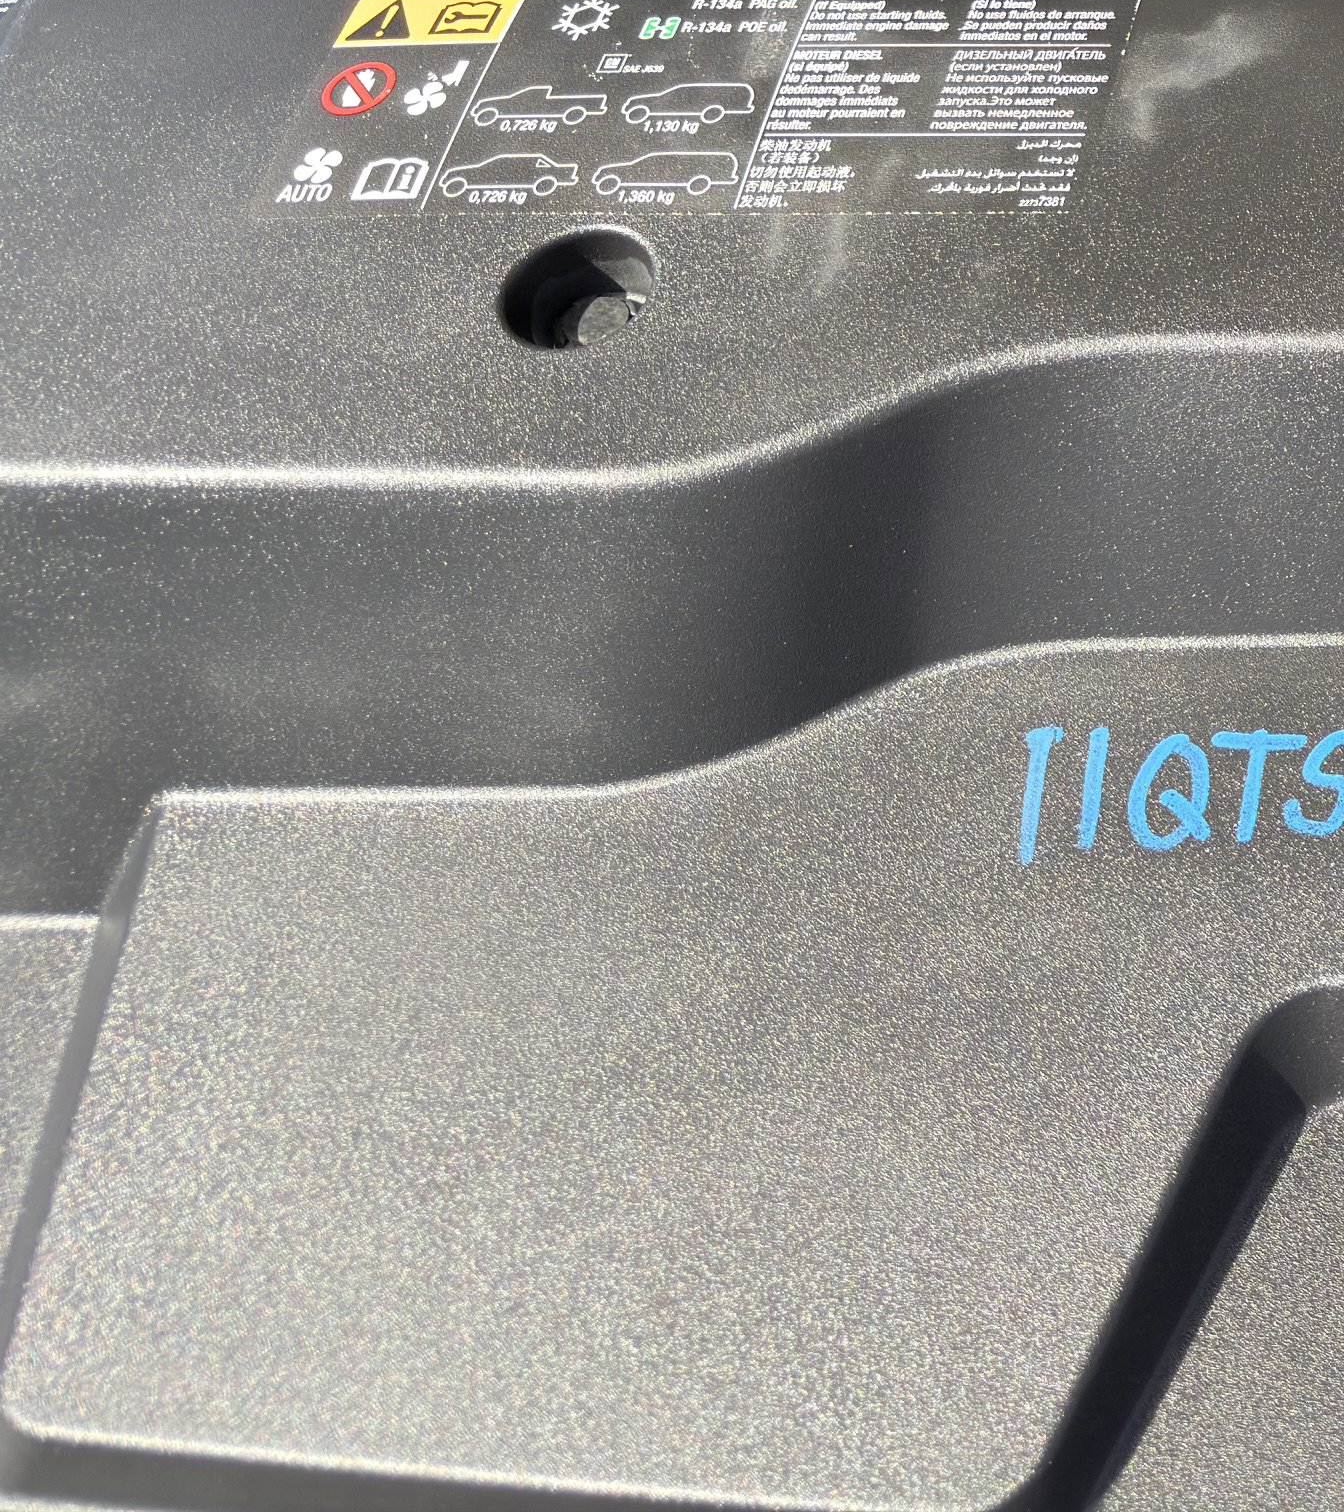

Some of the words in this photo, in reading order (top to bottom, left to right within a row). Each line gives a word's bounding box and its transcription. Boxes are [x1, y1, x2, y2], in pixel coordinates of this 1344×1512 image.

[681, 22, 732, 33] R-134a
[738, 22, 768, 32] POE
[769, 21, 788, 32] oil.
[793, 50, 842, 60] MOTEUR
[843, 50, 883, 60] DIESEL
[500, 120, 538, 132] 0,726
[539, 120, 558, 132] kg
[644, 120, 681, 133] 1,130
[681, 121, 700, 134] kg
[275, 183, 332, 203] AUTO
[469, 191, 507, 204] 0,726
[509, 191, 527, 204] kg
[617, 191, 655, 204] 1,360
[656, 191, 675, 205] kg
